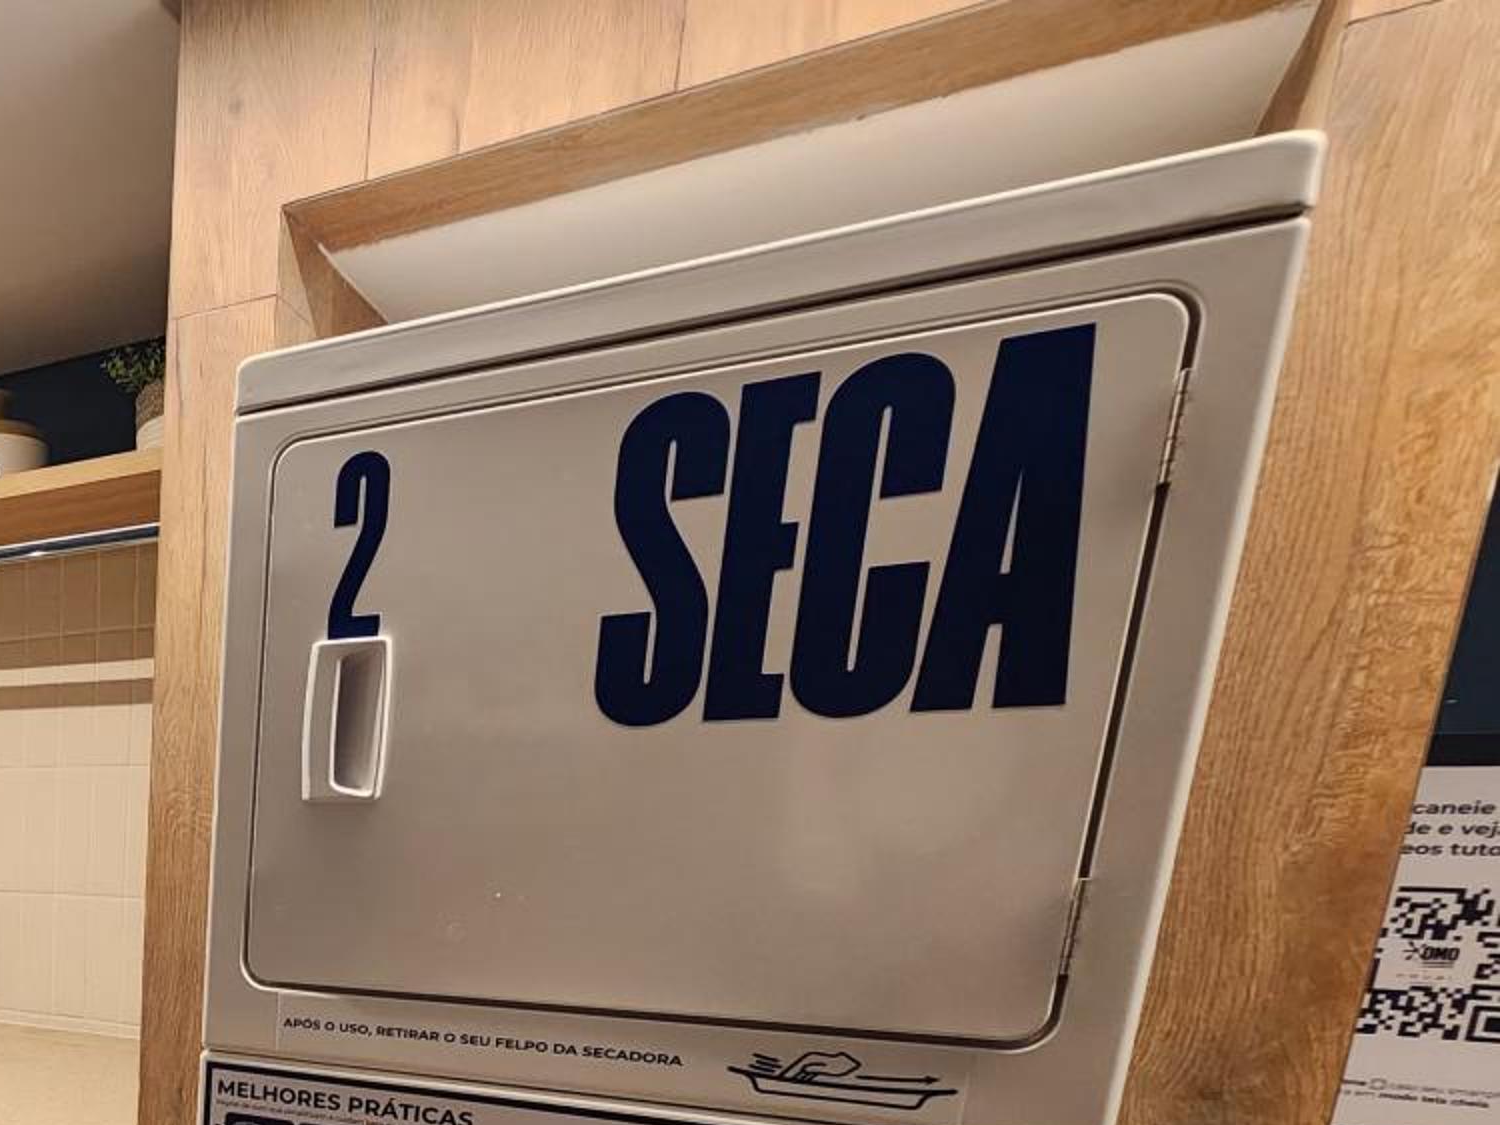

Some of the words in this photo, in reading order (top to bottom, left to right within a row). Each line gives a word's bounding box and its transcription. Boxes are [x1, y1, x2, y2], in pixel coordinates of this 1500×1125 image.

[327, 450, 392, 639] 2
[595, 323, 1097, 727] SECA
[1438, 824, 1453, 835] e
[1420, 945, 1461, 961] OMO
[284, 1016, 321, 1031] APÓS
[325, 1021, 336, 1032] O
[339, 1022, 373, 1037] USO,
[376, 1026, 440, 1043] RETIRAR
[443, 1033, 456, 1044] O
[460, 1033, 491, 1047] SEU
[495, 1037, 549, 1054] FELPO
[553, 1042, 578, 1057] DA
[582, 1044, 683, 1067] SECADORA
[217, 1079, 341, 1110] MELHORES
